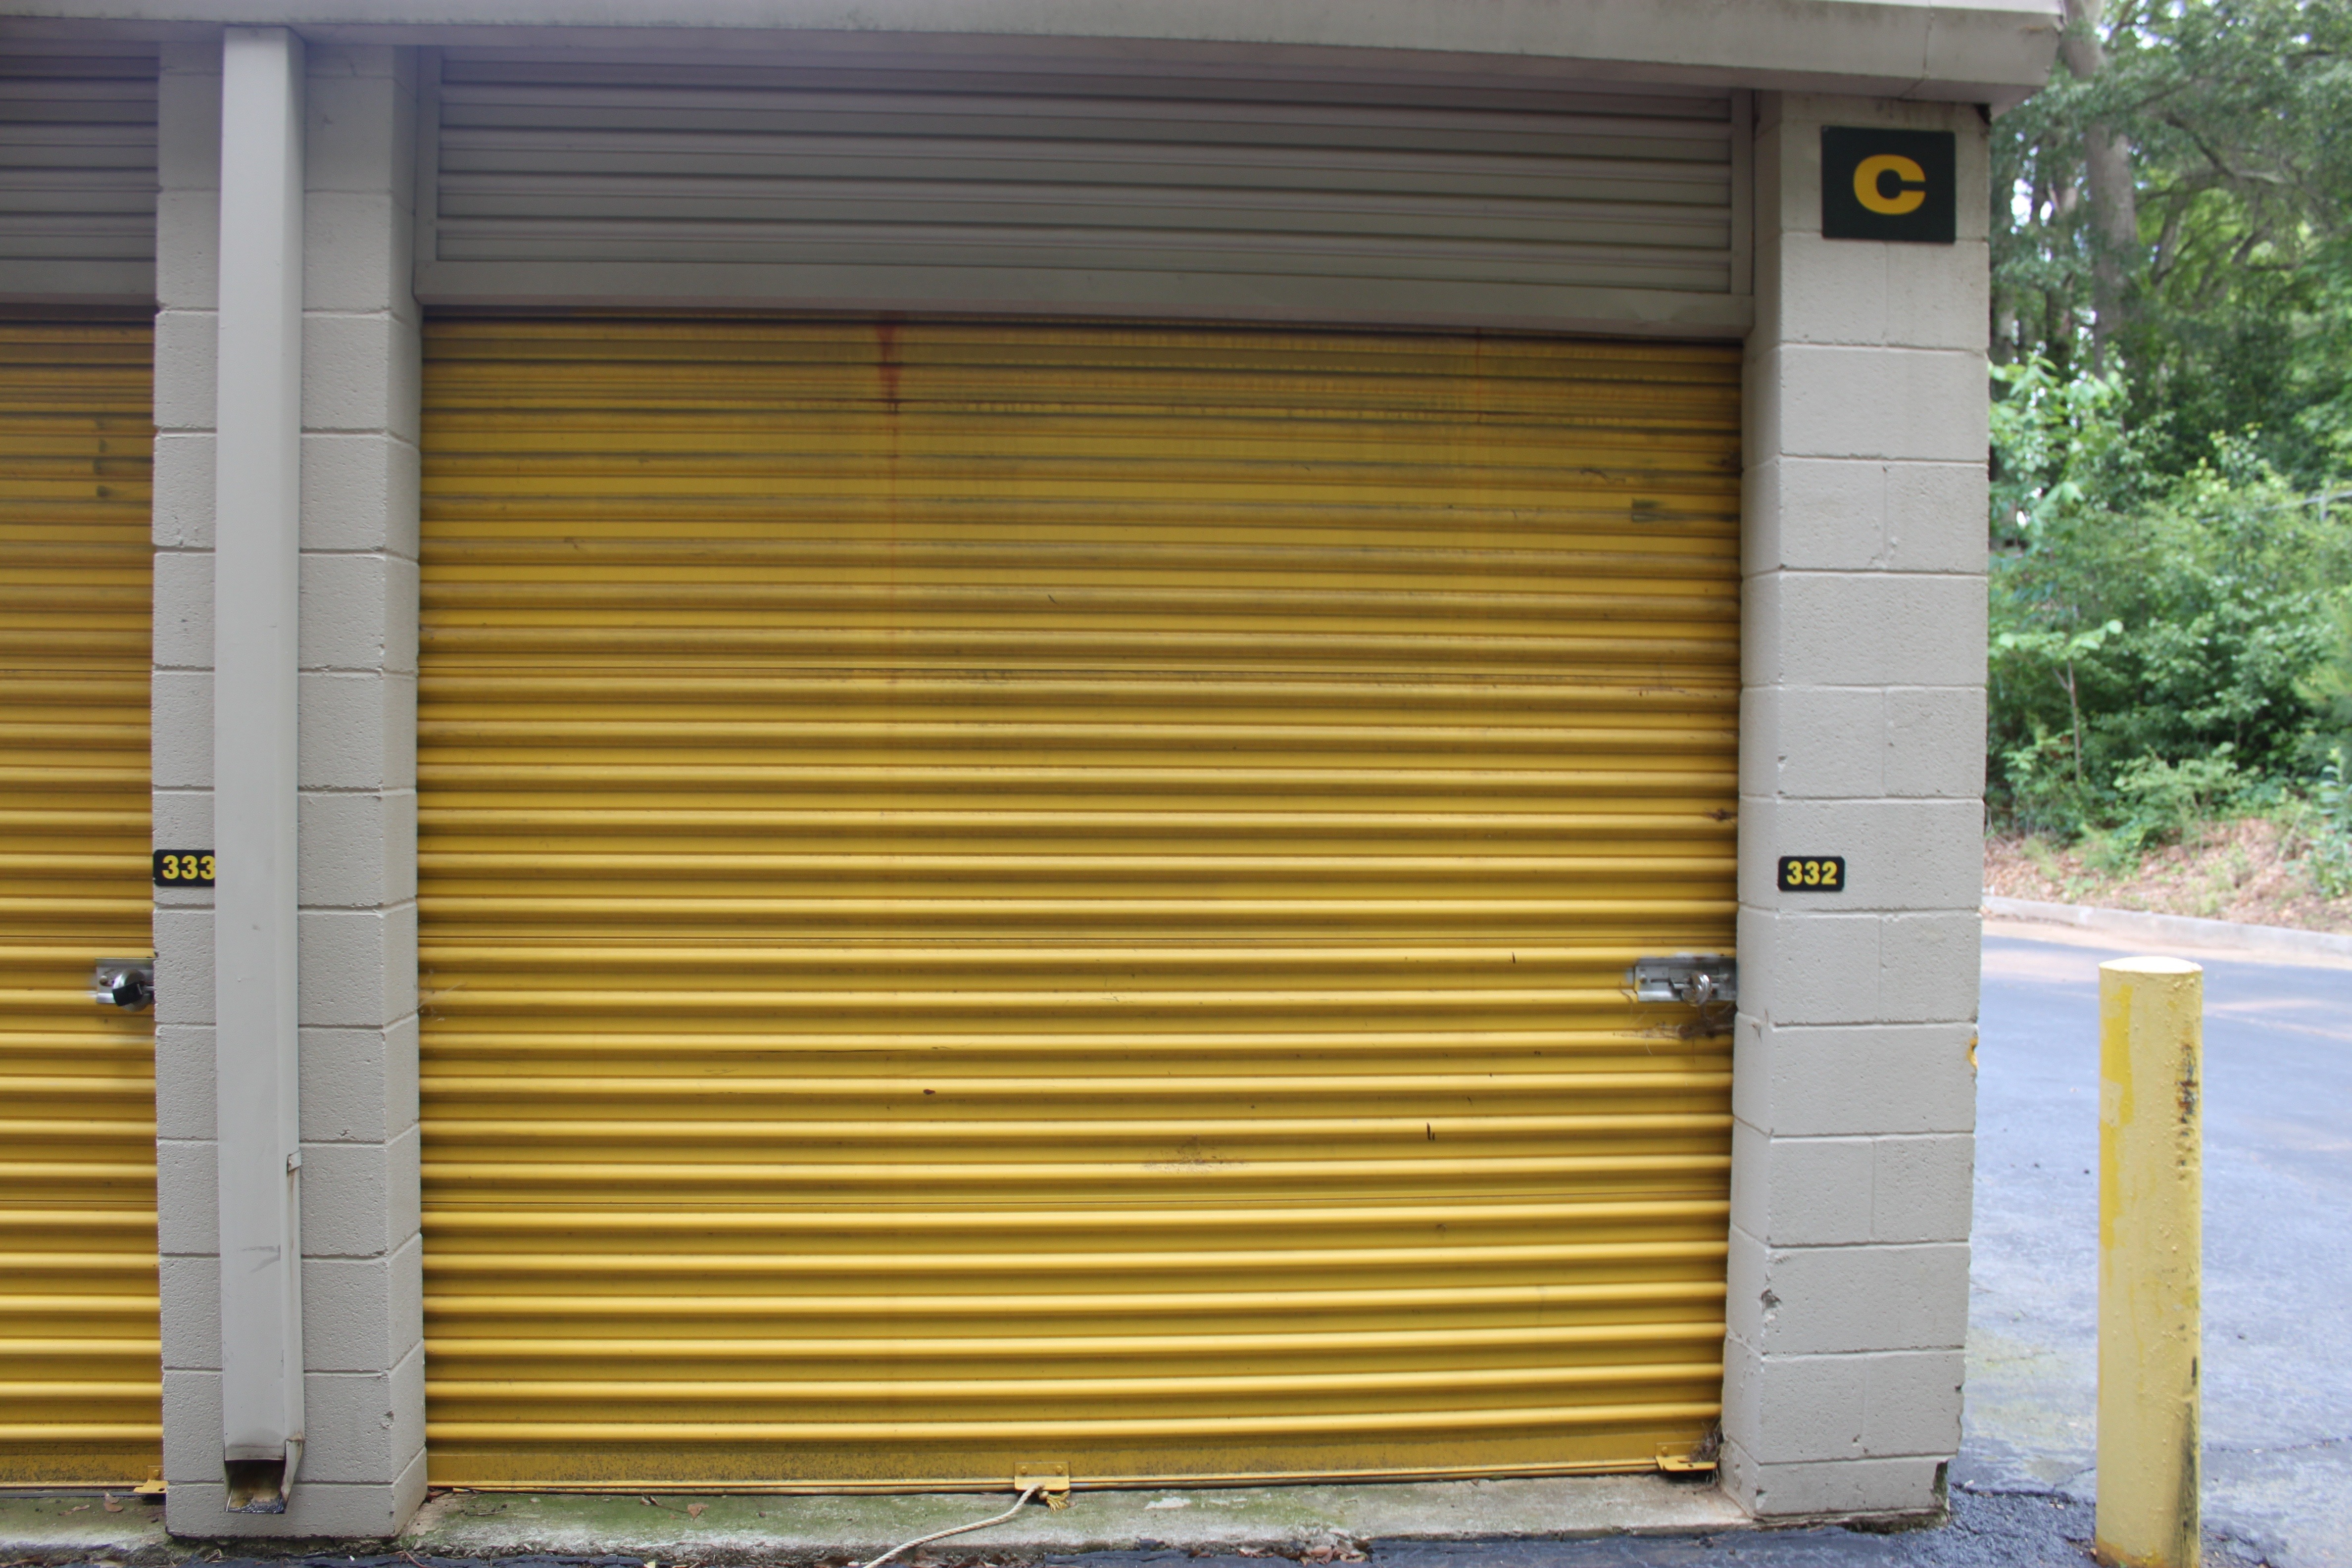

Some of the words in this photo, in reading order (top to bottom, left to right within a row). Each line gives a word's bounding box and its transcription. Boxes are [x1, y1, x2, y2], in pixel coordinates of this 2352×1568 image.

[1853, 154, 1926, 215] C
[162, 855, 215, 880] 333
[1787, 860, 1837, 885] 332
